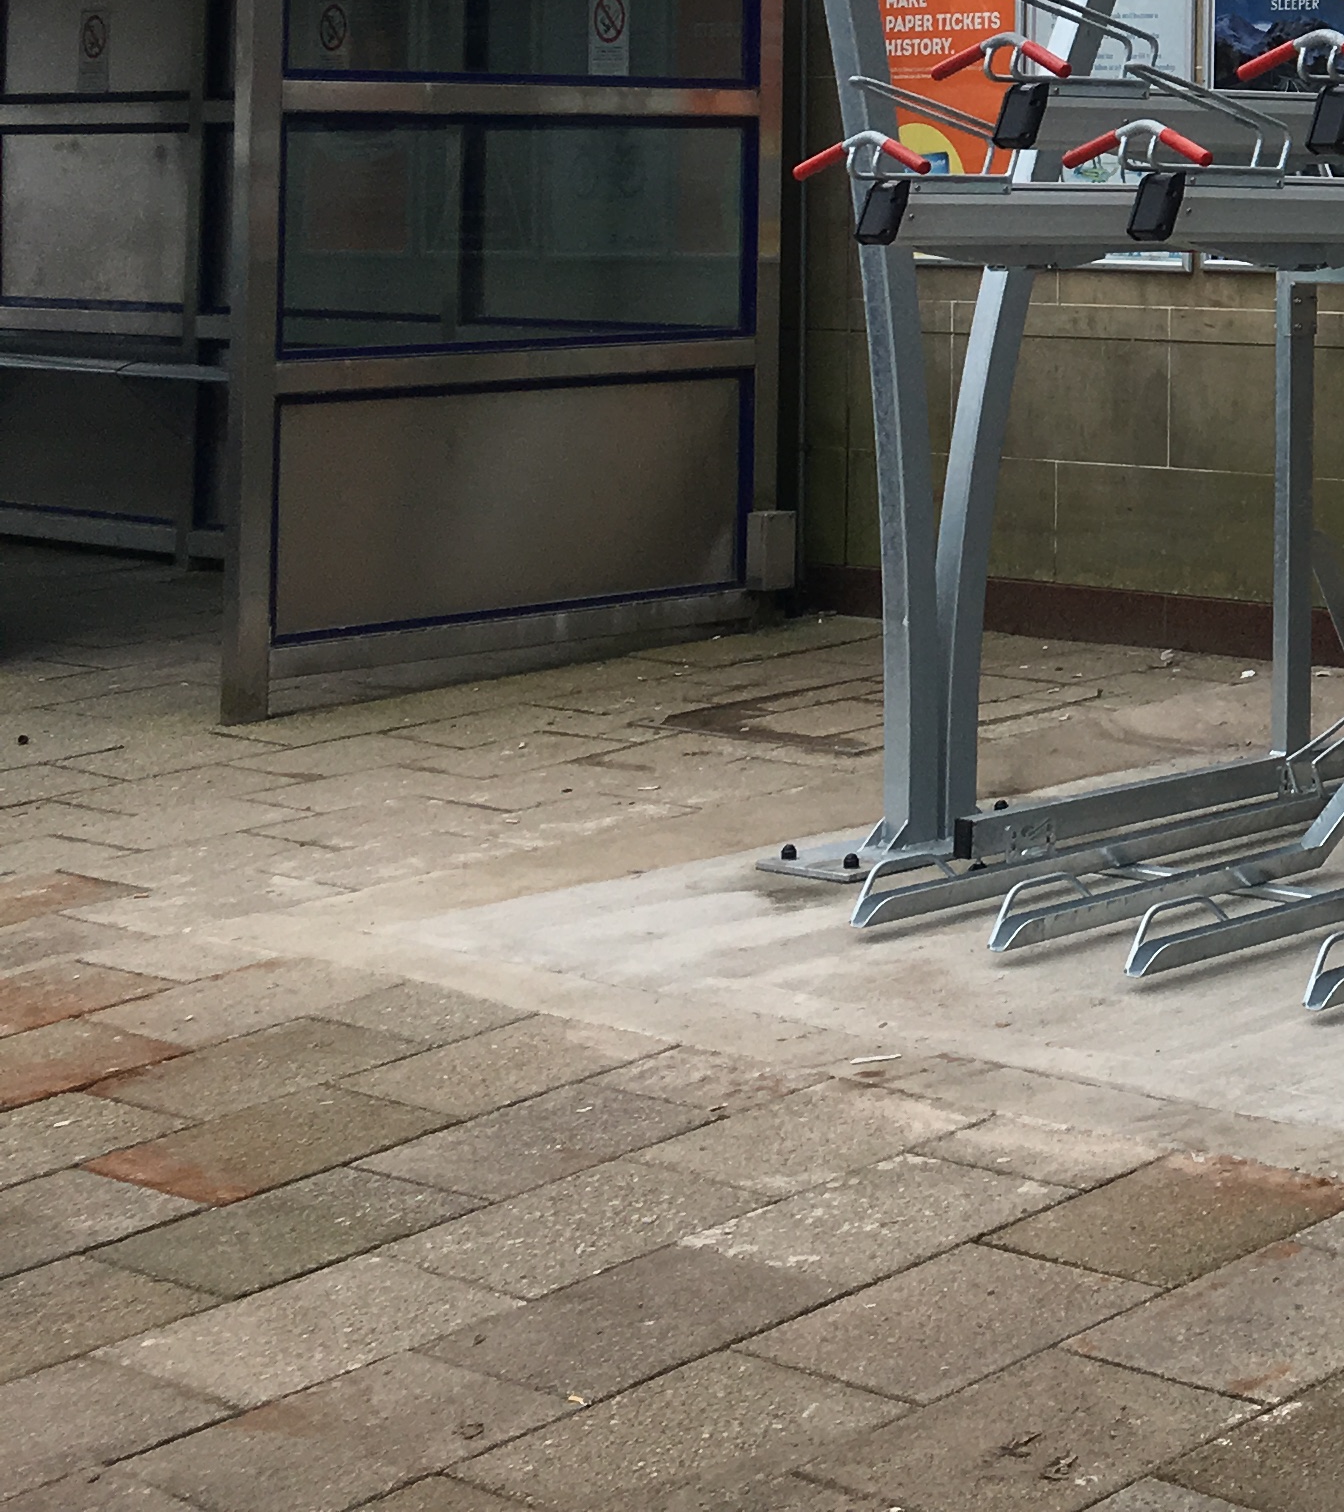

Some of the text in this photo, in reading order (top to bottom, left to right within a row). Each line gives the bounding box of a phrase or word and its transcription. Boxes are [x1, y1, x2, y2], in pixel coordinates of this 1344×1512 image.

[885, 12, 1001, 33] PAPER TICKETS
[885, 38, 955, 56] HISTORY.
